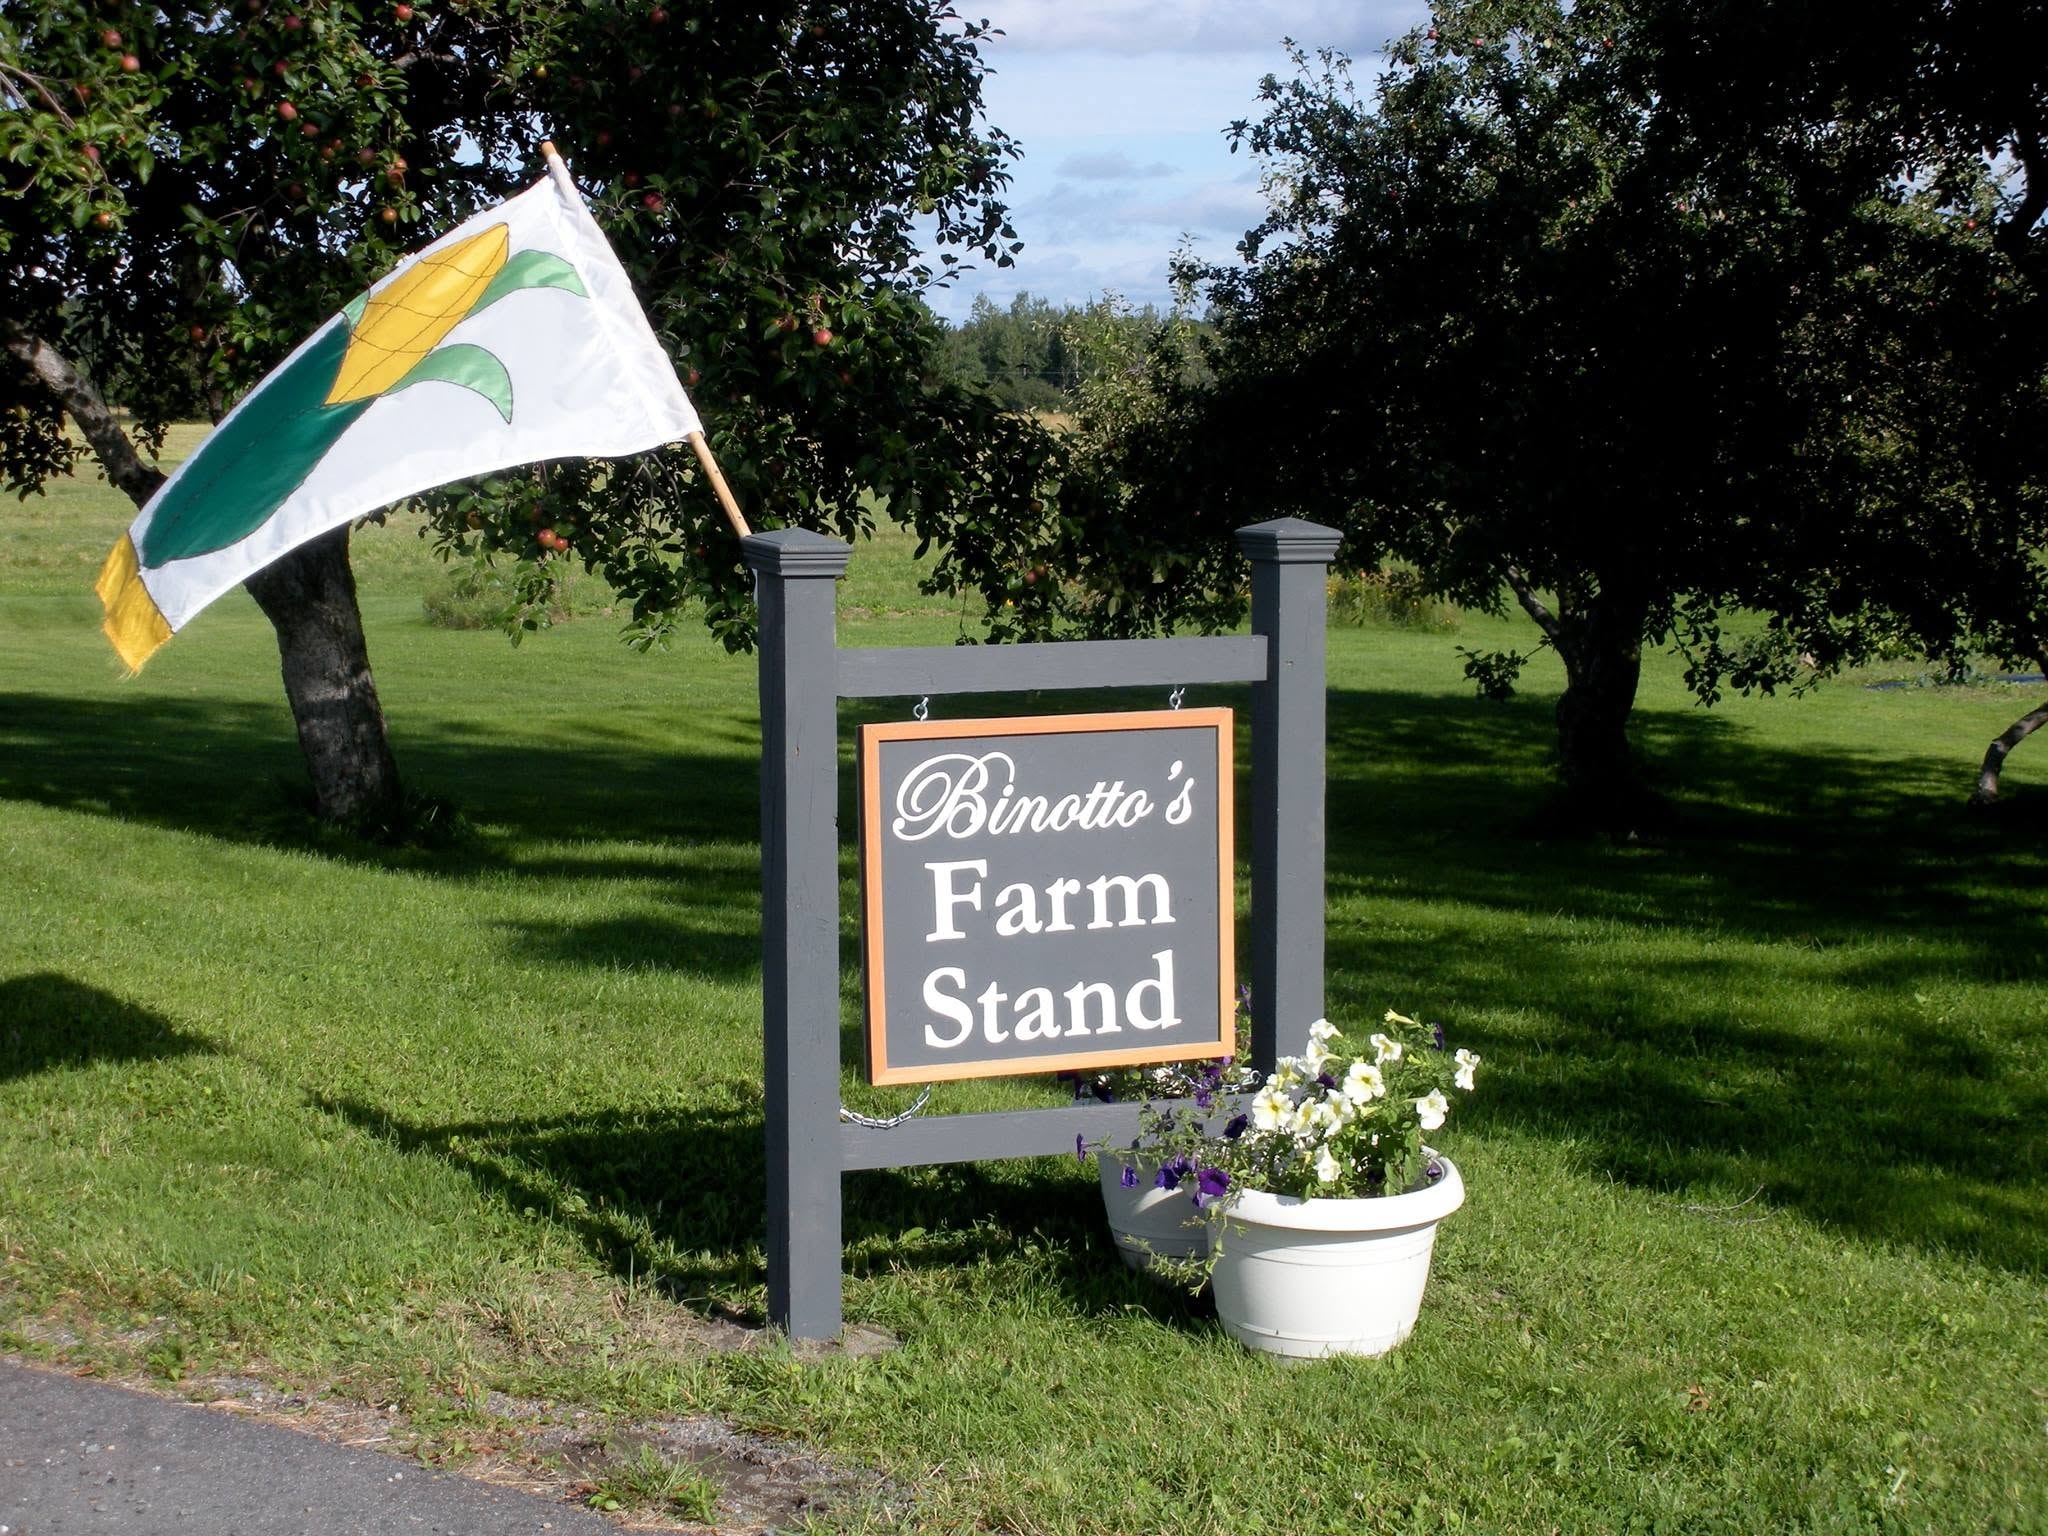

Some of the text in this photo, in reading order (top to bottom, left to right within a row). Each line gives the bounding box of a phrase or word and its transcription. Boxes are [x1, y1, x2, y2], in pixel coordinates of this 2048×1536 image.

[892, 751, 1196, 842] Binotto's
[923, 858, 1177, 943] Farm
[922, 948, 1183, 1049] Stand
